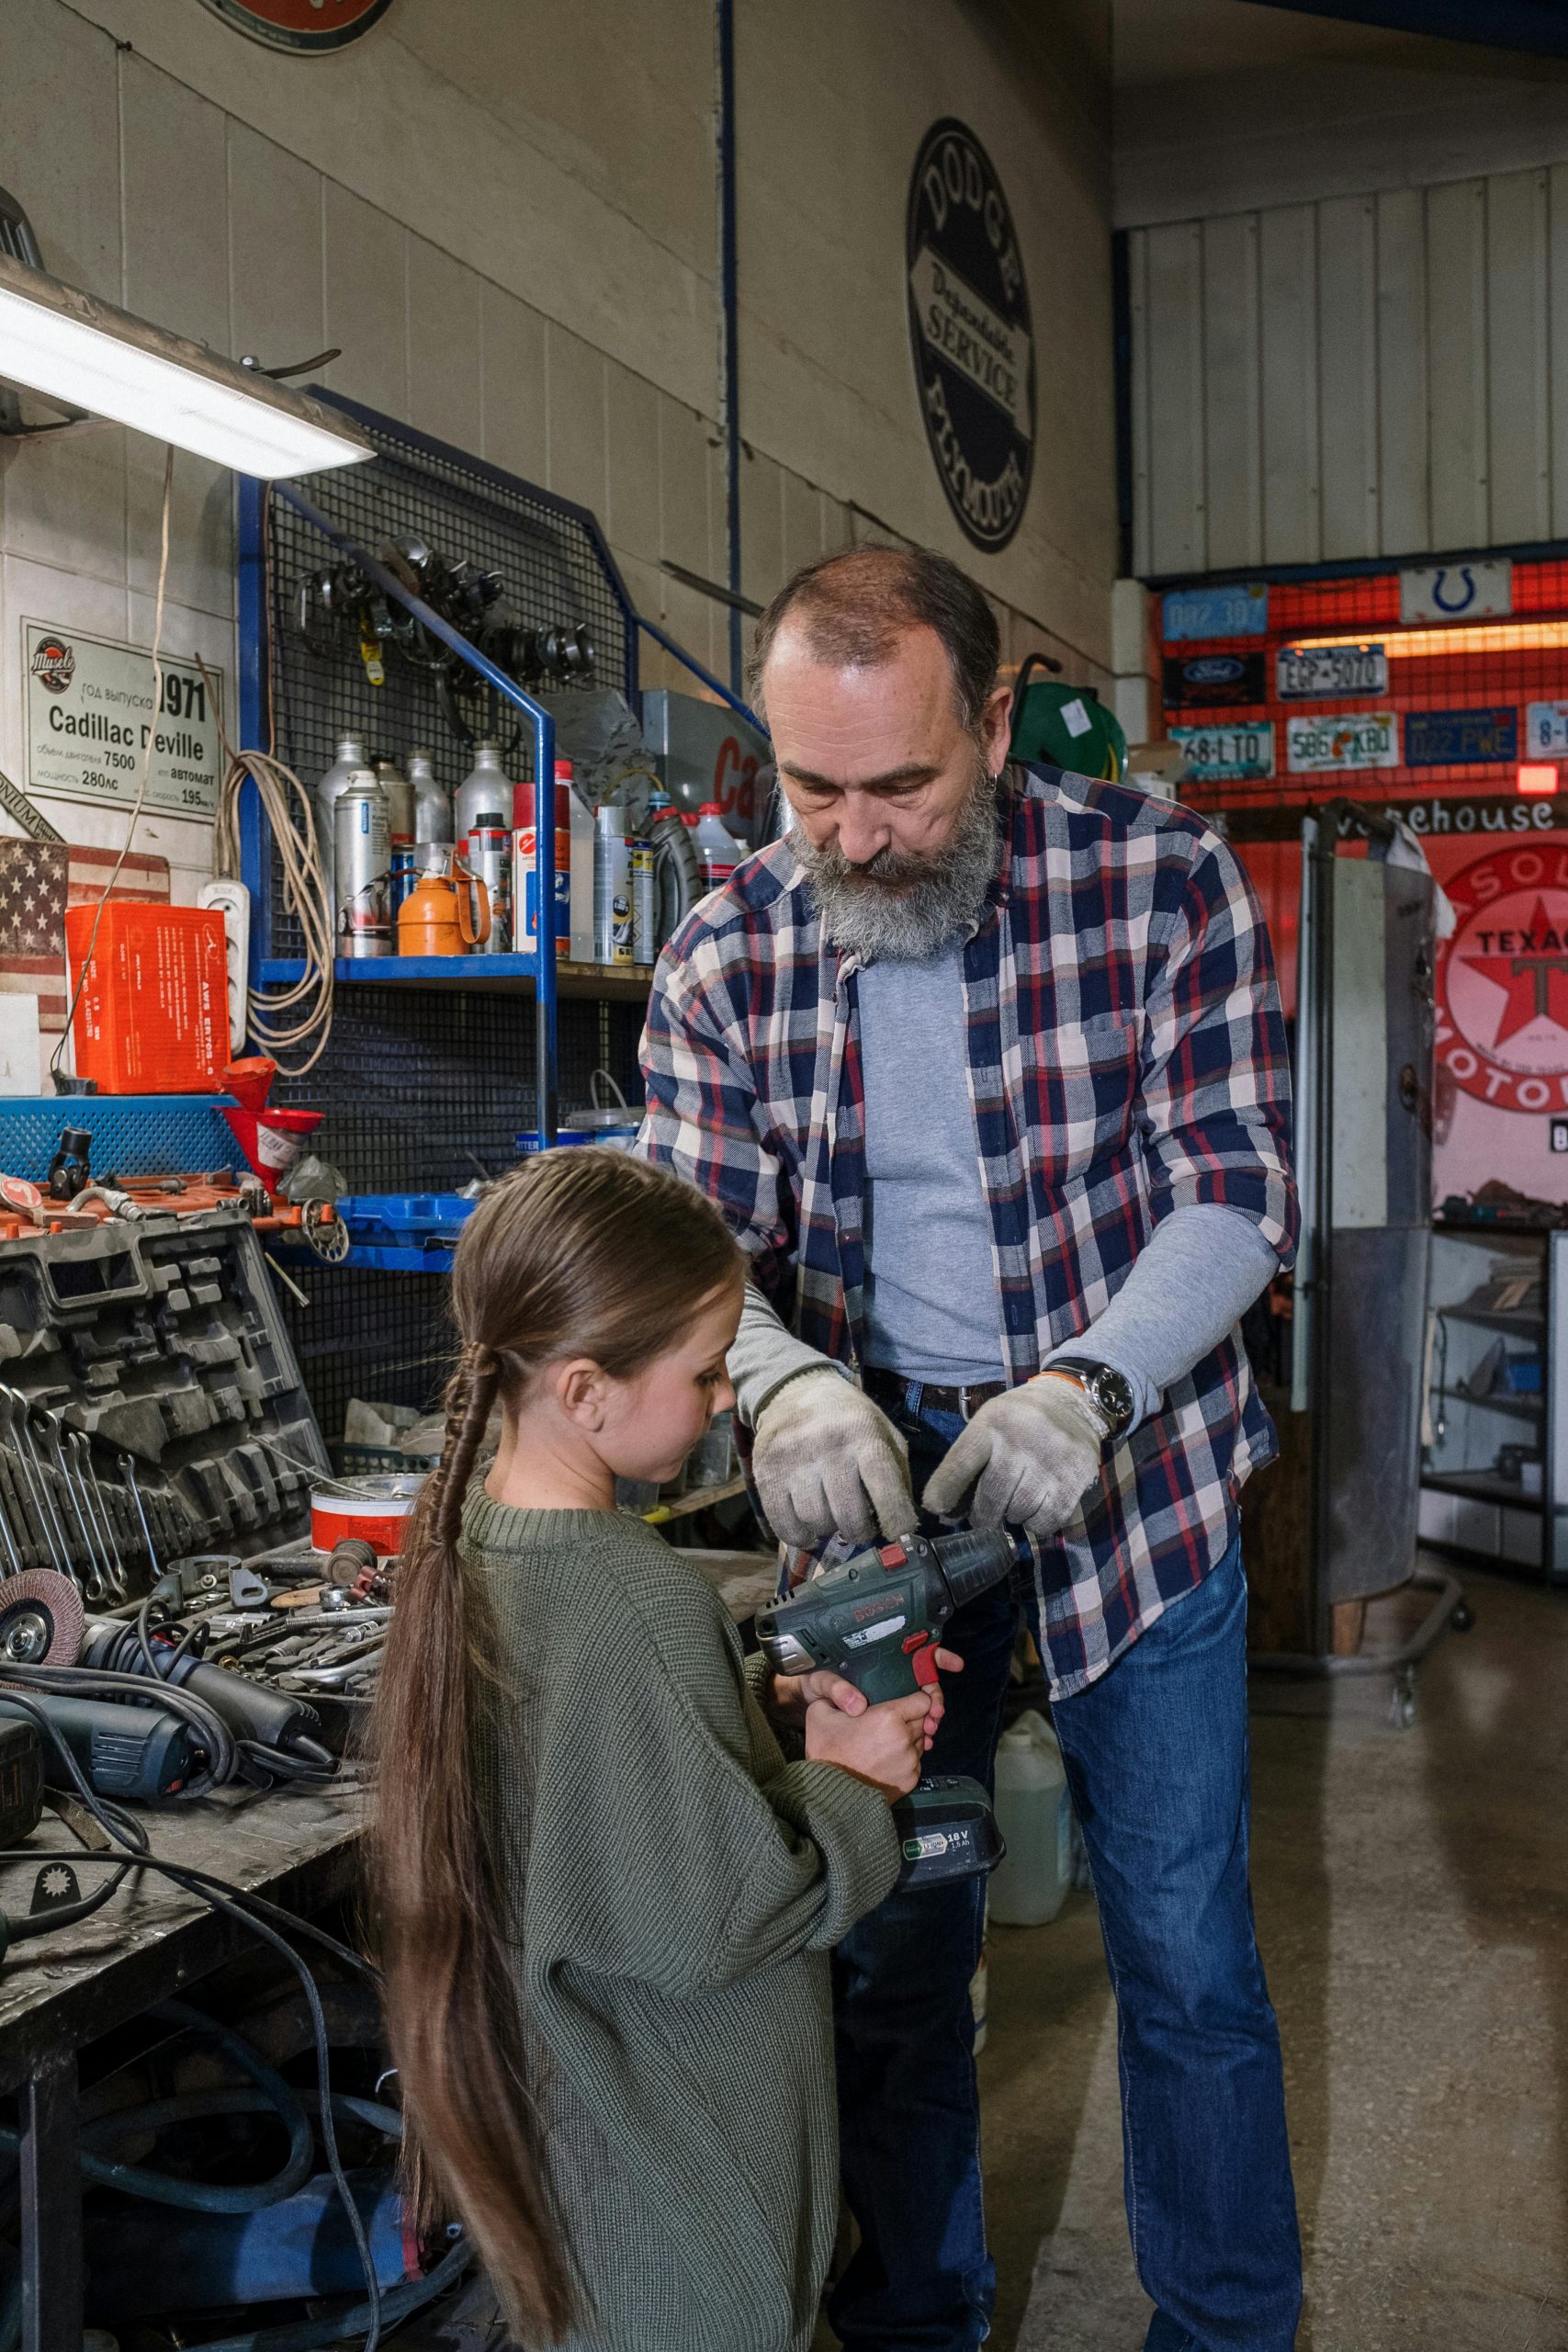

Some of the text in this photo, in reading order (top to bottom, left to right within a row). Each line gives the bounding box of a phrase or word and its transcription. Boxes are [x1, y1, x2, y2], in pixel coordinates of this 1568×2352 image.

[925, 143, 1022, 303] DODGE
[927, 303, 1019, 409] SERVICE
[153, 672, 206, 723] 1971
[49, 705, 204, 761] Cadillac Deville
[103, 750, 136, 771] 7500
[171, 767, 215, 786] автомат
[1476, 929, 1568, 955] TEXA
[852, 1593, 906, 1624] BOSCH
[947, 1829, 968, 1843] 18 V
